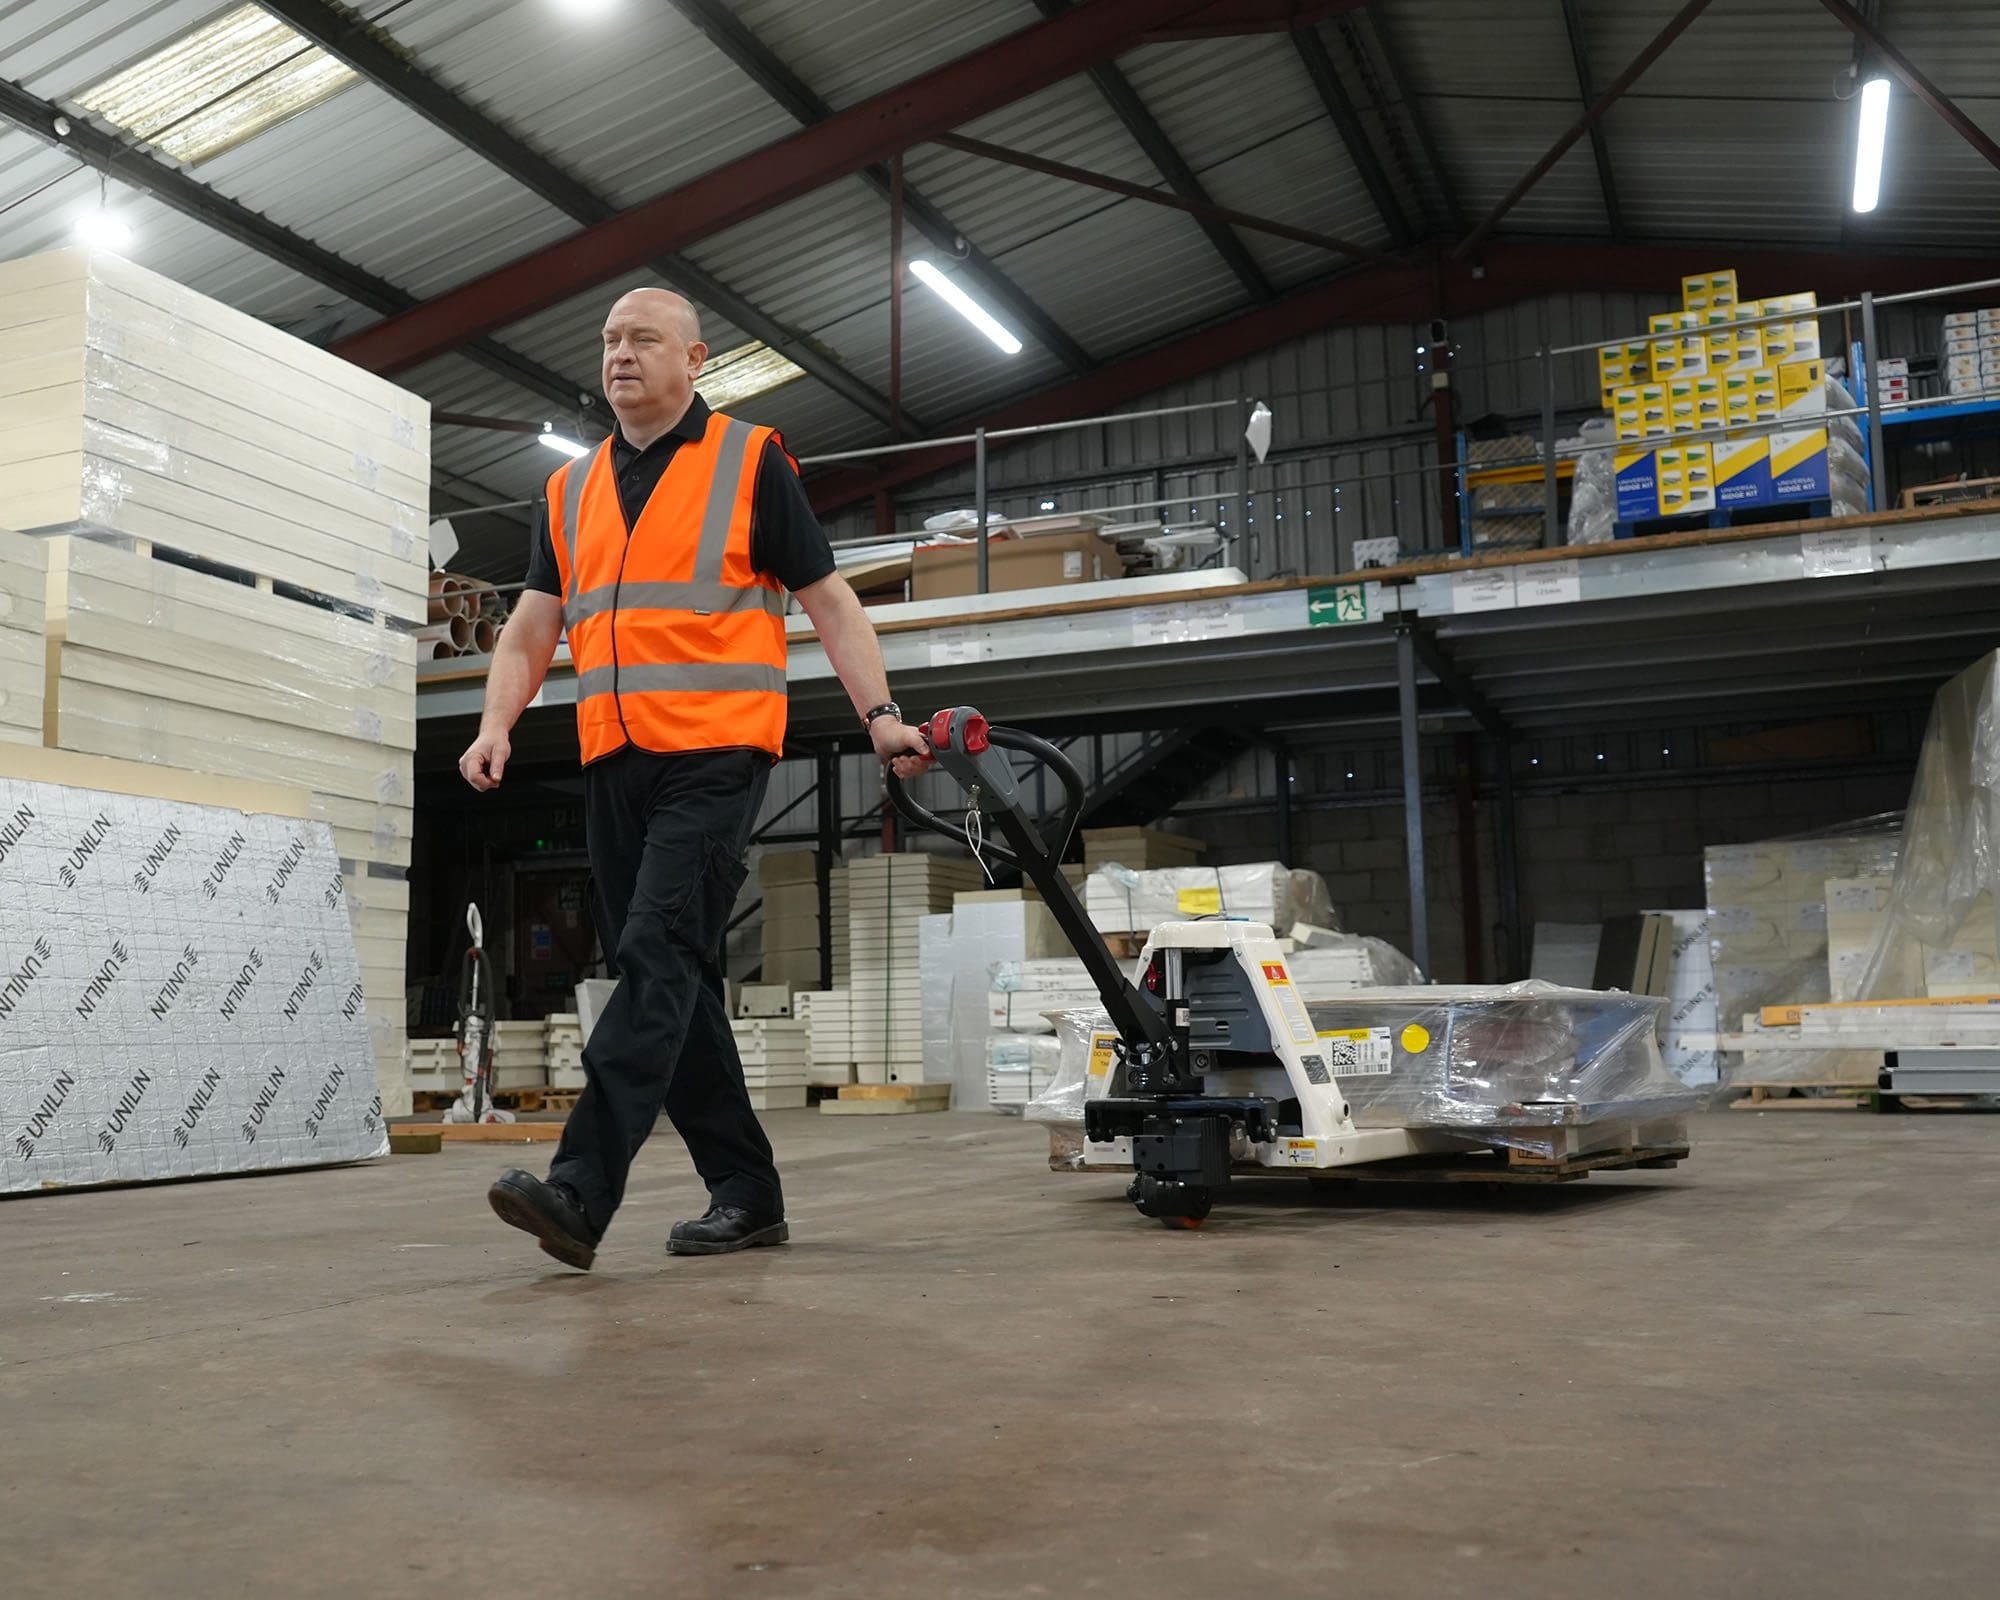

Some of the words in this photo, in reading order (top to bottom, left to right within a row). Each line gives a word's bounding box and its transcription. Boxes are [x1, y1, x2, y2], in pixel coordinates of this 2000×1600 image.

[1618, 483, 1641, 492] RIDGE
[1641, 480, 1653, 489] KIT
[1720, 484, 1757, 494] UNIVERSAL
[1721, 492, 1744, 500] RIDGE
[1745, 489, 1758, 498] KIT
[1777, 477, 1815, 487] UNIVERSAL
[1778, 484, 1801, 493] RIDGE
[1802, 482, 1815, 491] KIT
[68, 812, 112, 871] UNILIN
[142, 822, 182, 878] UNILIN
[210, 830, 246, 883] UNILIN
[273, 838, 306, 889] UNILIN
[75, 958, 120, 1021] UNILIN
[151, 961, 191, 1021] UNILIN
[220, 964, 257, 1022] UNILIN
[283, 966, 317, 1022] UNILIN
[27, 1070, 75, 1138] UNILIN
[107, 1069, 151, 1134] UNILIN
[181, 1067, 221, 1129] UNILIN
[249, 1065, 285, 1125] UNILIN
[312, 1064, 344, 1121] UNILIN
